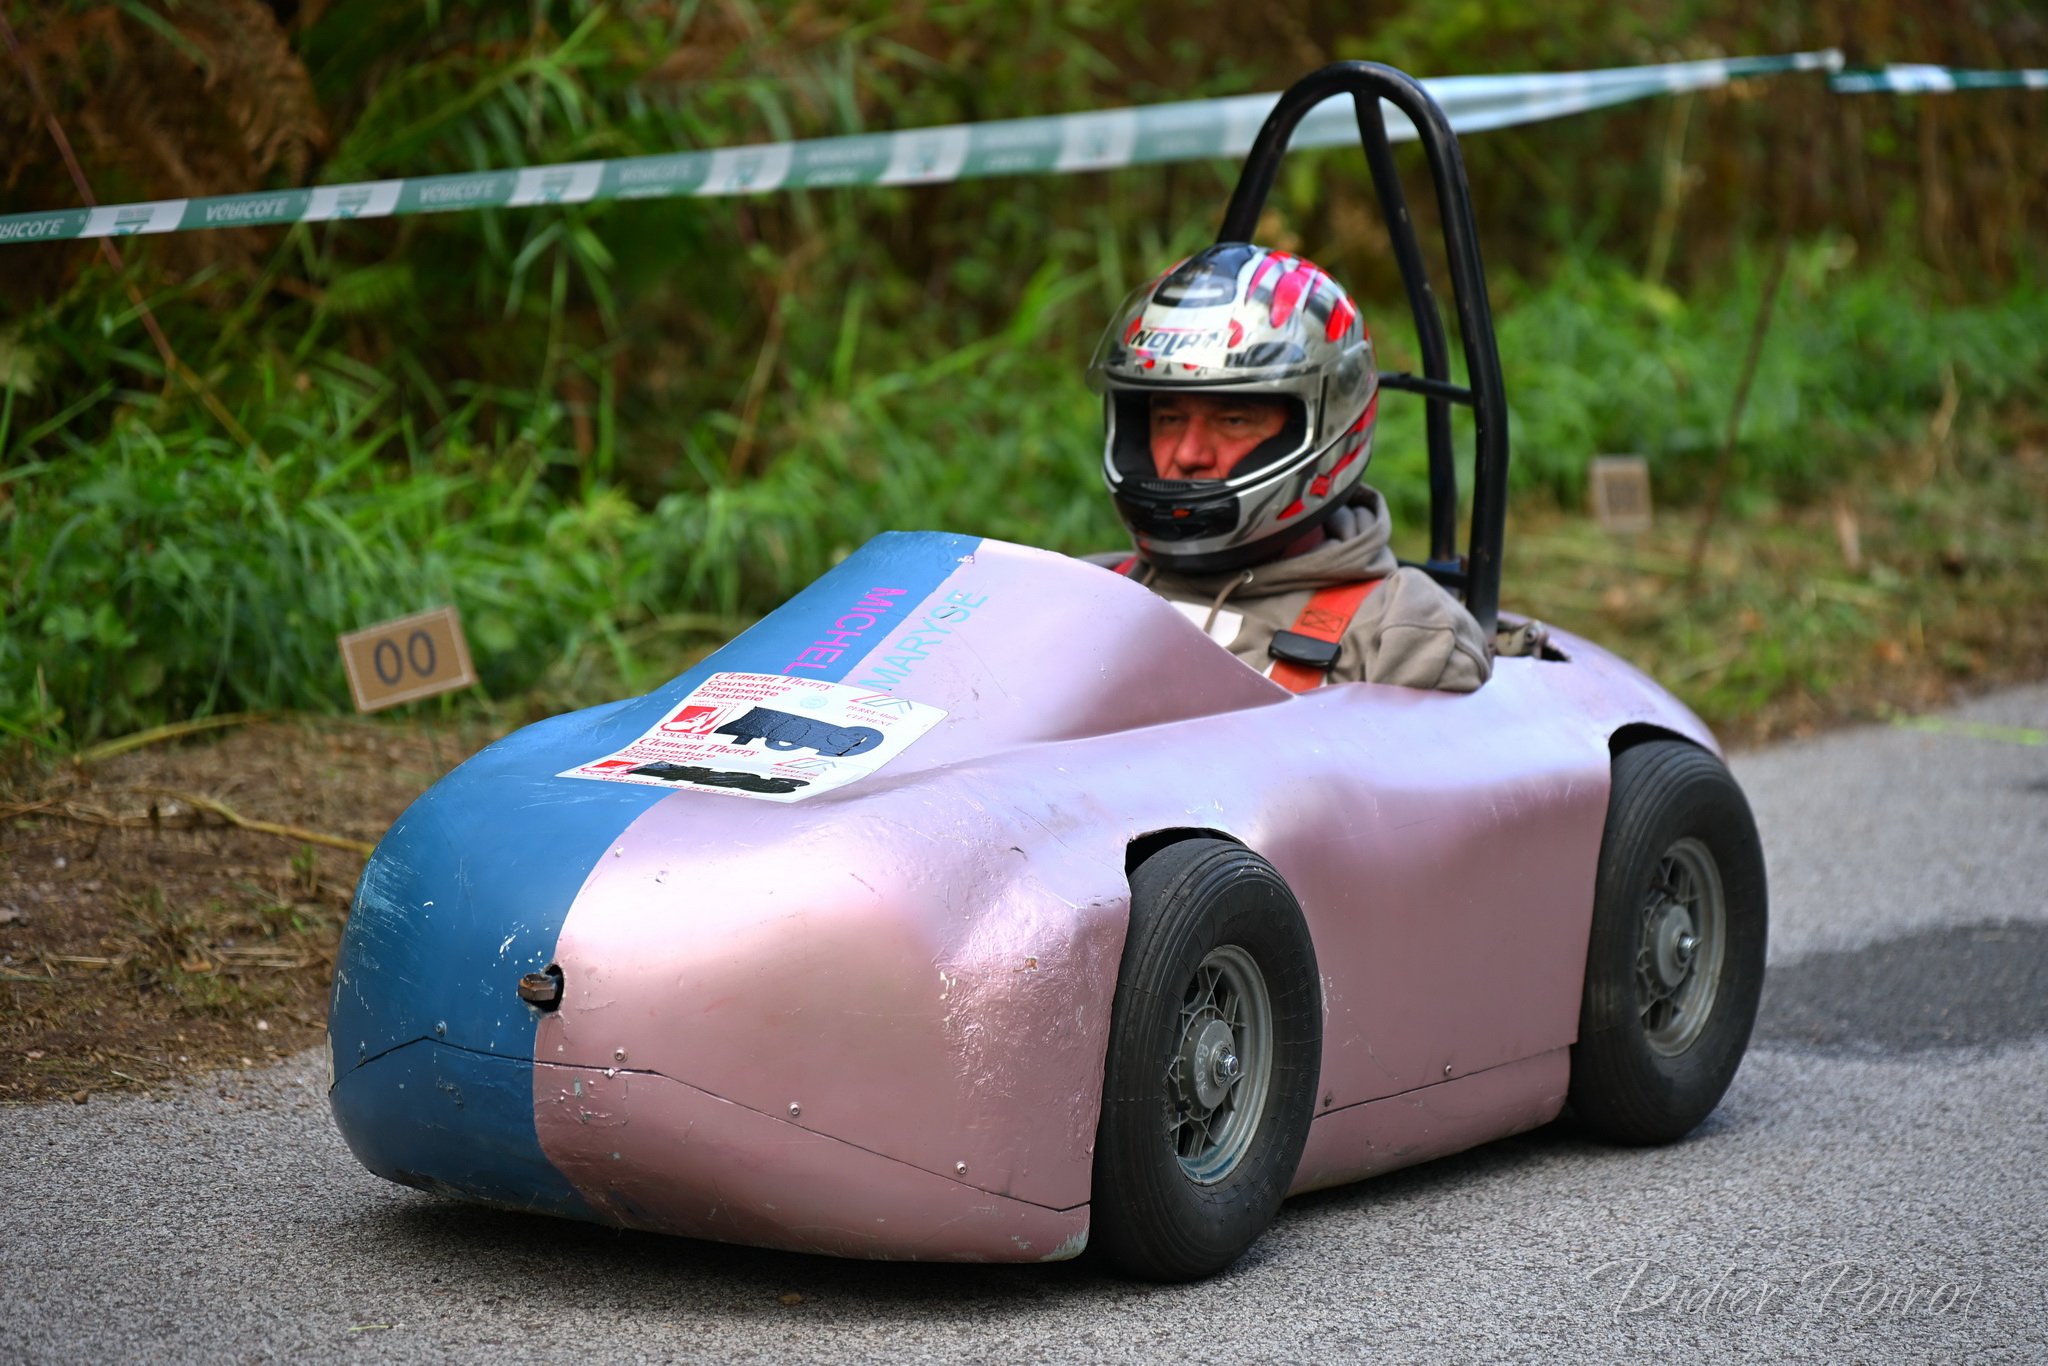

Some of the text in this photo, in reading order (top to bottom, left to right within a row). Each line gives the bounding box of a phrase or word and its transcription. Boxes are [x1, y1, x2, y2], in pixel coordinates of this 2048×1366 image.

[782, 587, 908, 674] MICHEL
[858, 589, 988, 691] MARYSE
[374, 630, 436, 687] 00
[701, 686, 779, 697] Charpente
[707, 680, 791, 692] Couverture
[693, 691, 764, 702] Zinguerie
[638, 737, 705, 751] Clement
[630, 745, 716, 759] Couverture
